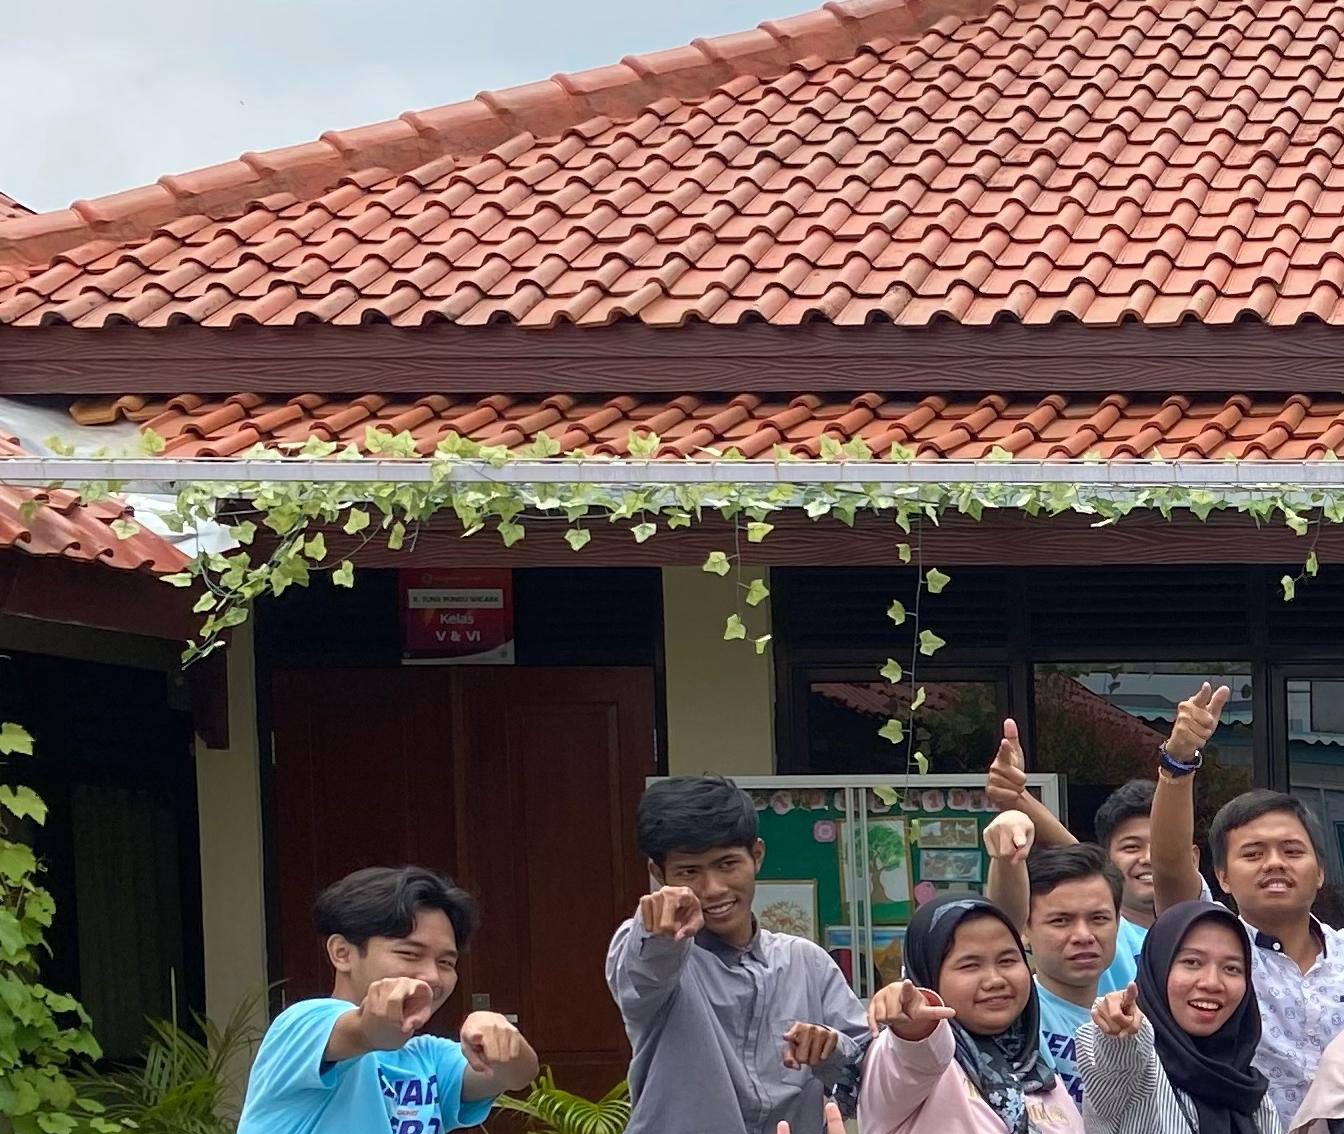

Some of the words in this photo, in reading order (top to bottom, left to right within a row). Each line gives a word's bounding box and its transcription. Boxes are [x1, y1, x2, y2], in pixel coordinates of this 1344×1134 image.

[440, 613, 474, 625] Kelas
[435, 631, 446, 642] V
[450, 631, 461, 642] &
[466, 631, 481, 642] VI
